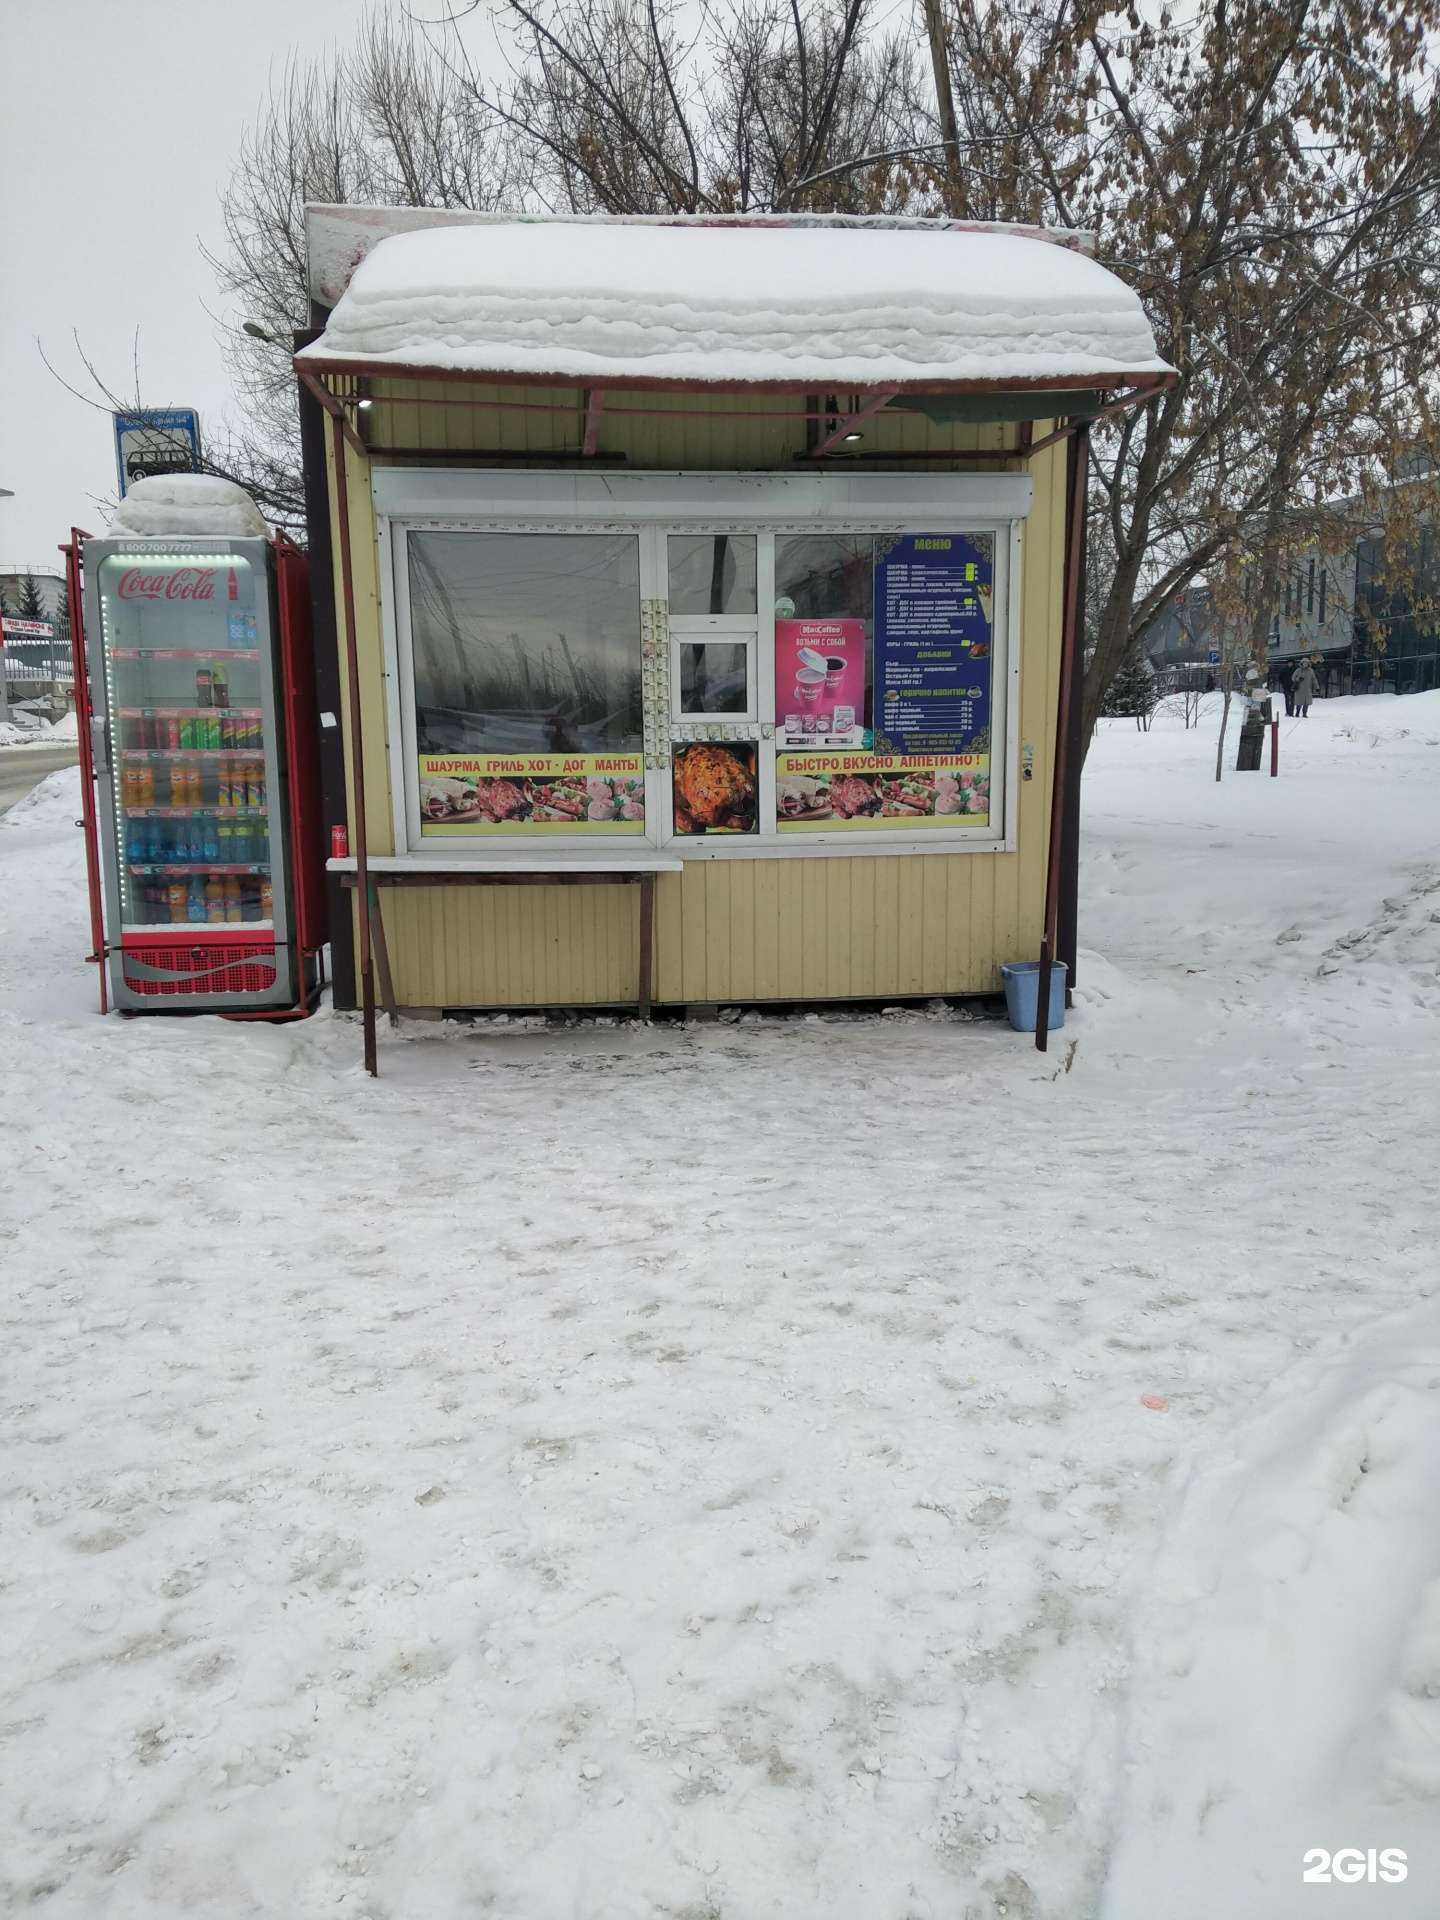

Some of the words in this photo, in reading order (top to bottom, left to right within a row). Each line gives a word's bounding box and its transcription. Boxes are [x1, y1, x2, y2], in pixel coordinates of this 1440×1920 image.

[802, 626, 841, 634] MacCoffee
[426, 760, 481, 772] ШАУРМА
[486, 759, 525, 772] ГРИЛЬ
[528, 759, 551, 772] ХОТ
[562, 759, 586, 773] ДОГ
[595, 758, 639, 771] МАНТЫ
